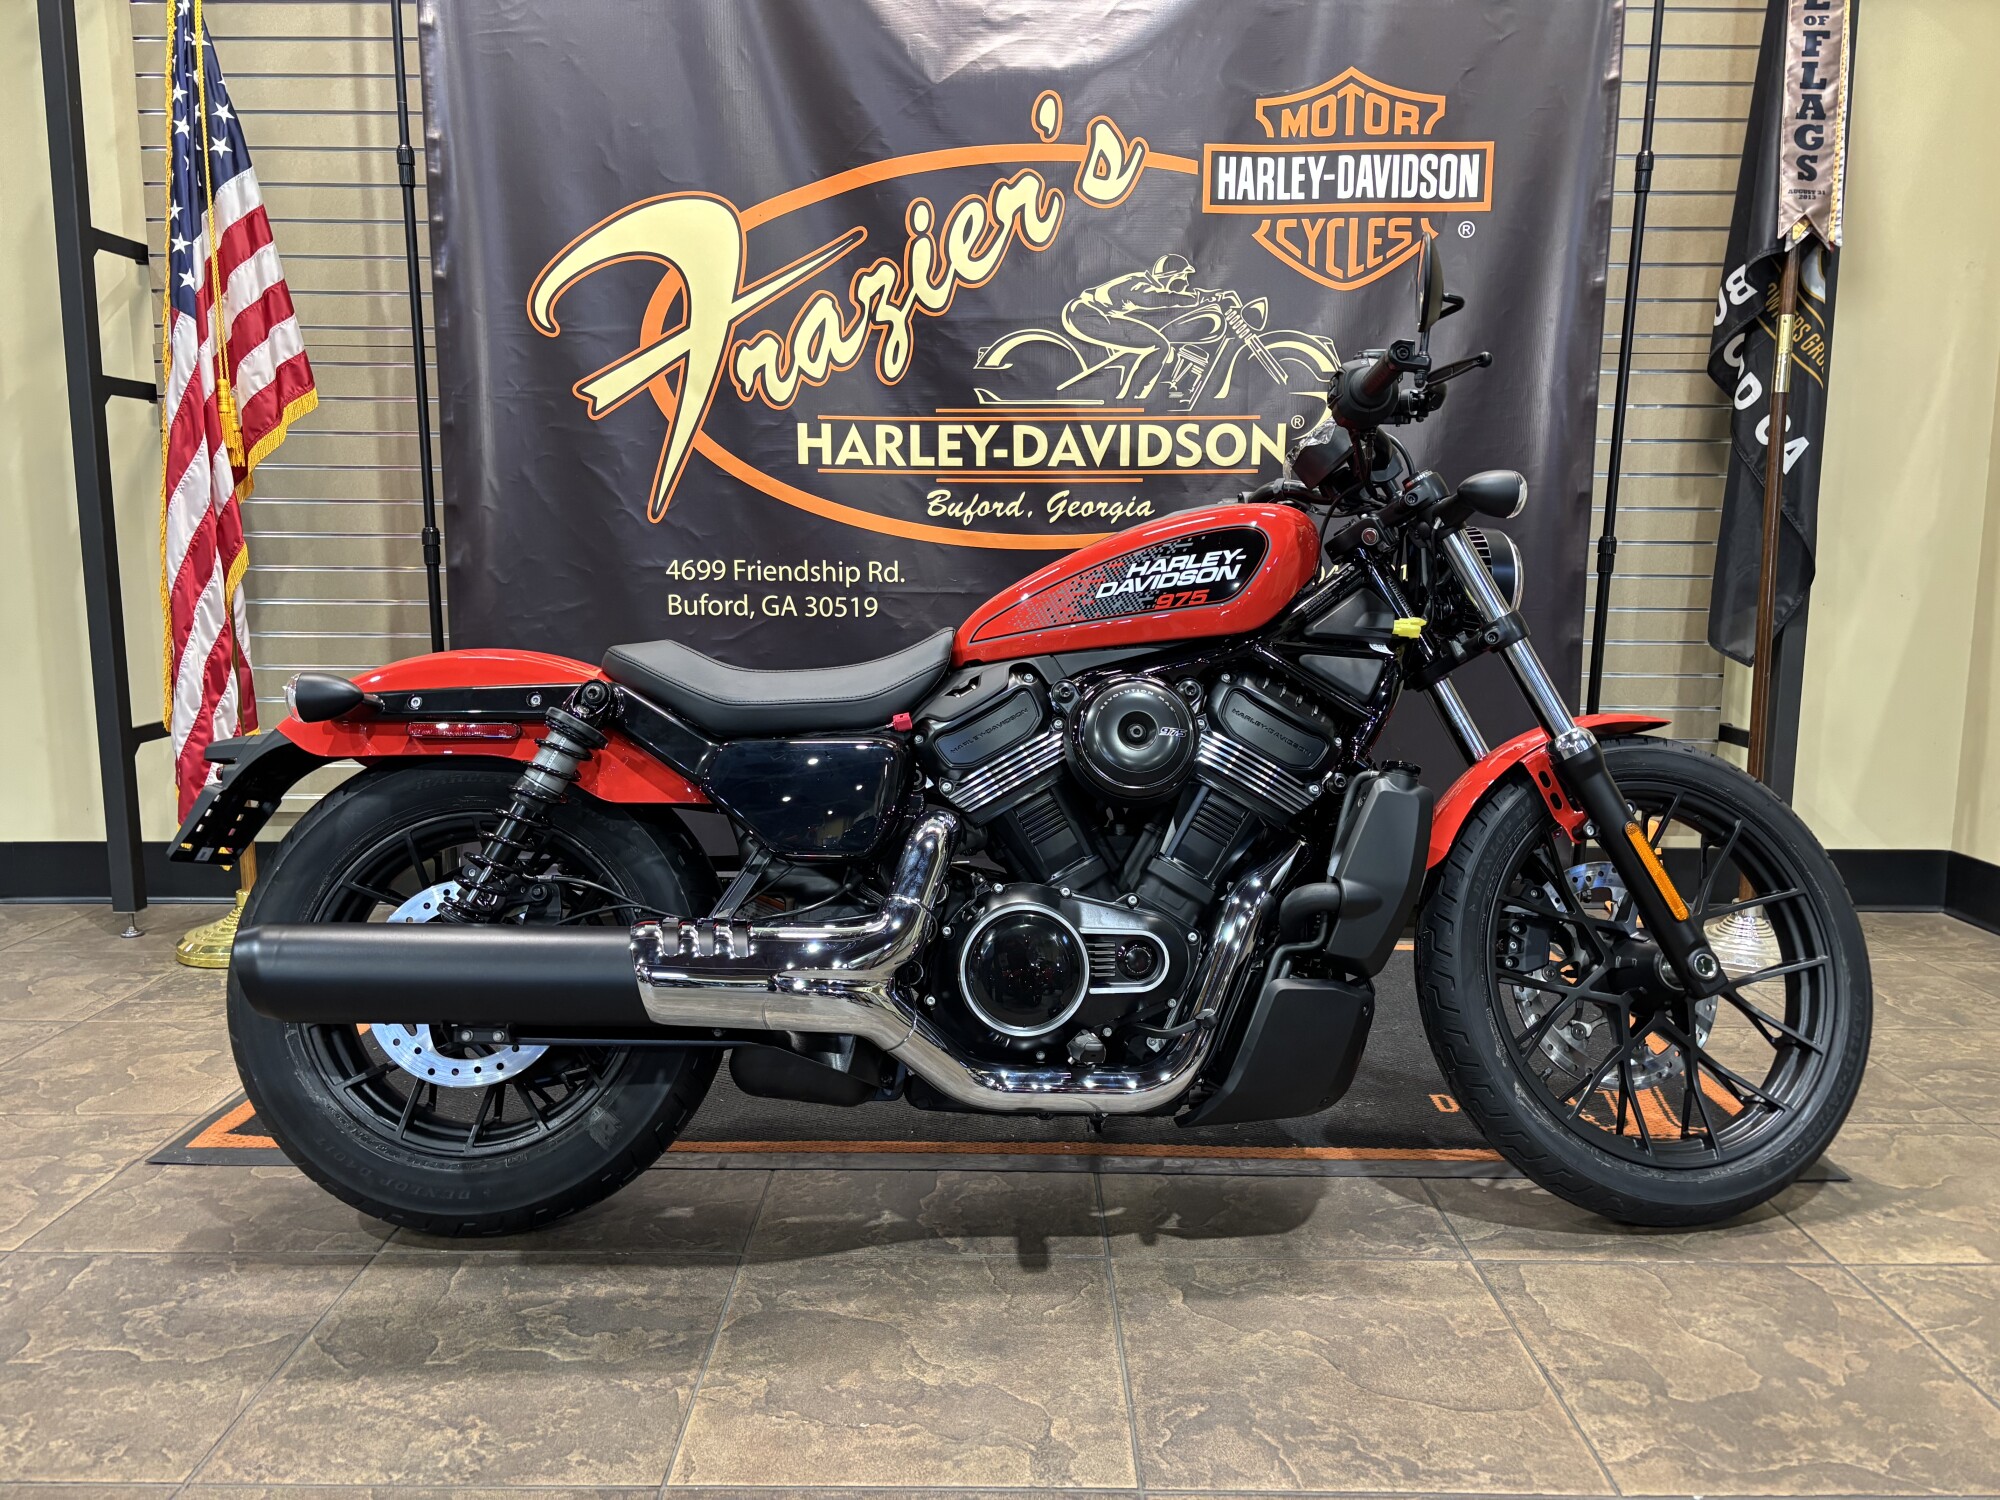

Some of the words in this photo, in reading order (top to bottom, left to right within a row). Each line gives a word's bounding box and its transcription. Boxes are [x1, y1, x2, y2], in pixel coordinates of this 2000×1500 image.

[1803, 15, 1830, 26] OF
[1281, 82, 1419, 138] MOTOR
[1793, 30, 1831, 182] FLAGS
[1217, 153, 1480, 201] HARLEY-DAVIDSON
[1276, 217, 1413, 279] CYCLES
[527, 89, 1151, 524] Frazier's
[797, 423, 1287, 468] HARLEY-DAVIDSON
[1046, 489, 1156, 524] Georgia
[665, 559, 727, 581] 4699
[734, 559, 861, 588] Friendship
[868, 560, 906, 583] Rd.
[1126, 547, 1247, 579] HARLEY-
[1095, 564, 1242, 599] DAVIDSON
[667, 593, 756, 619] Buford,
[761, 595, 798, 617] GA
[804, 596, 879, 618] 30519
[1154, 589, 1211, 610] 975
[1099, 688, 1154, 710] REVOLUTION
[950, 707, 1029, 754] HARLEY-DAVIDSON
[1159, 726, 1188, 738] 975
[1231, 707, 1313, 757] HARLEY-DAVIDSON
